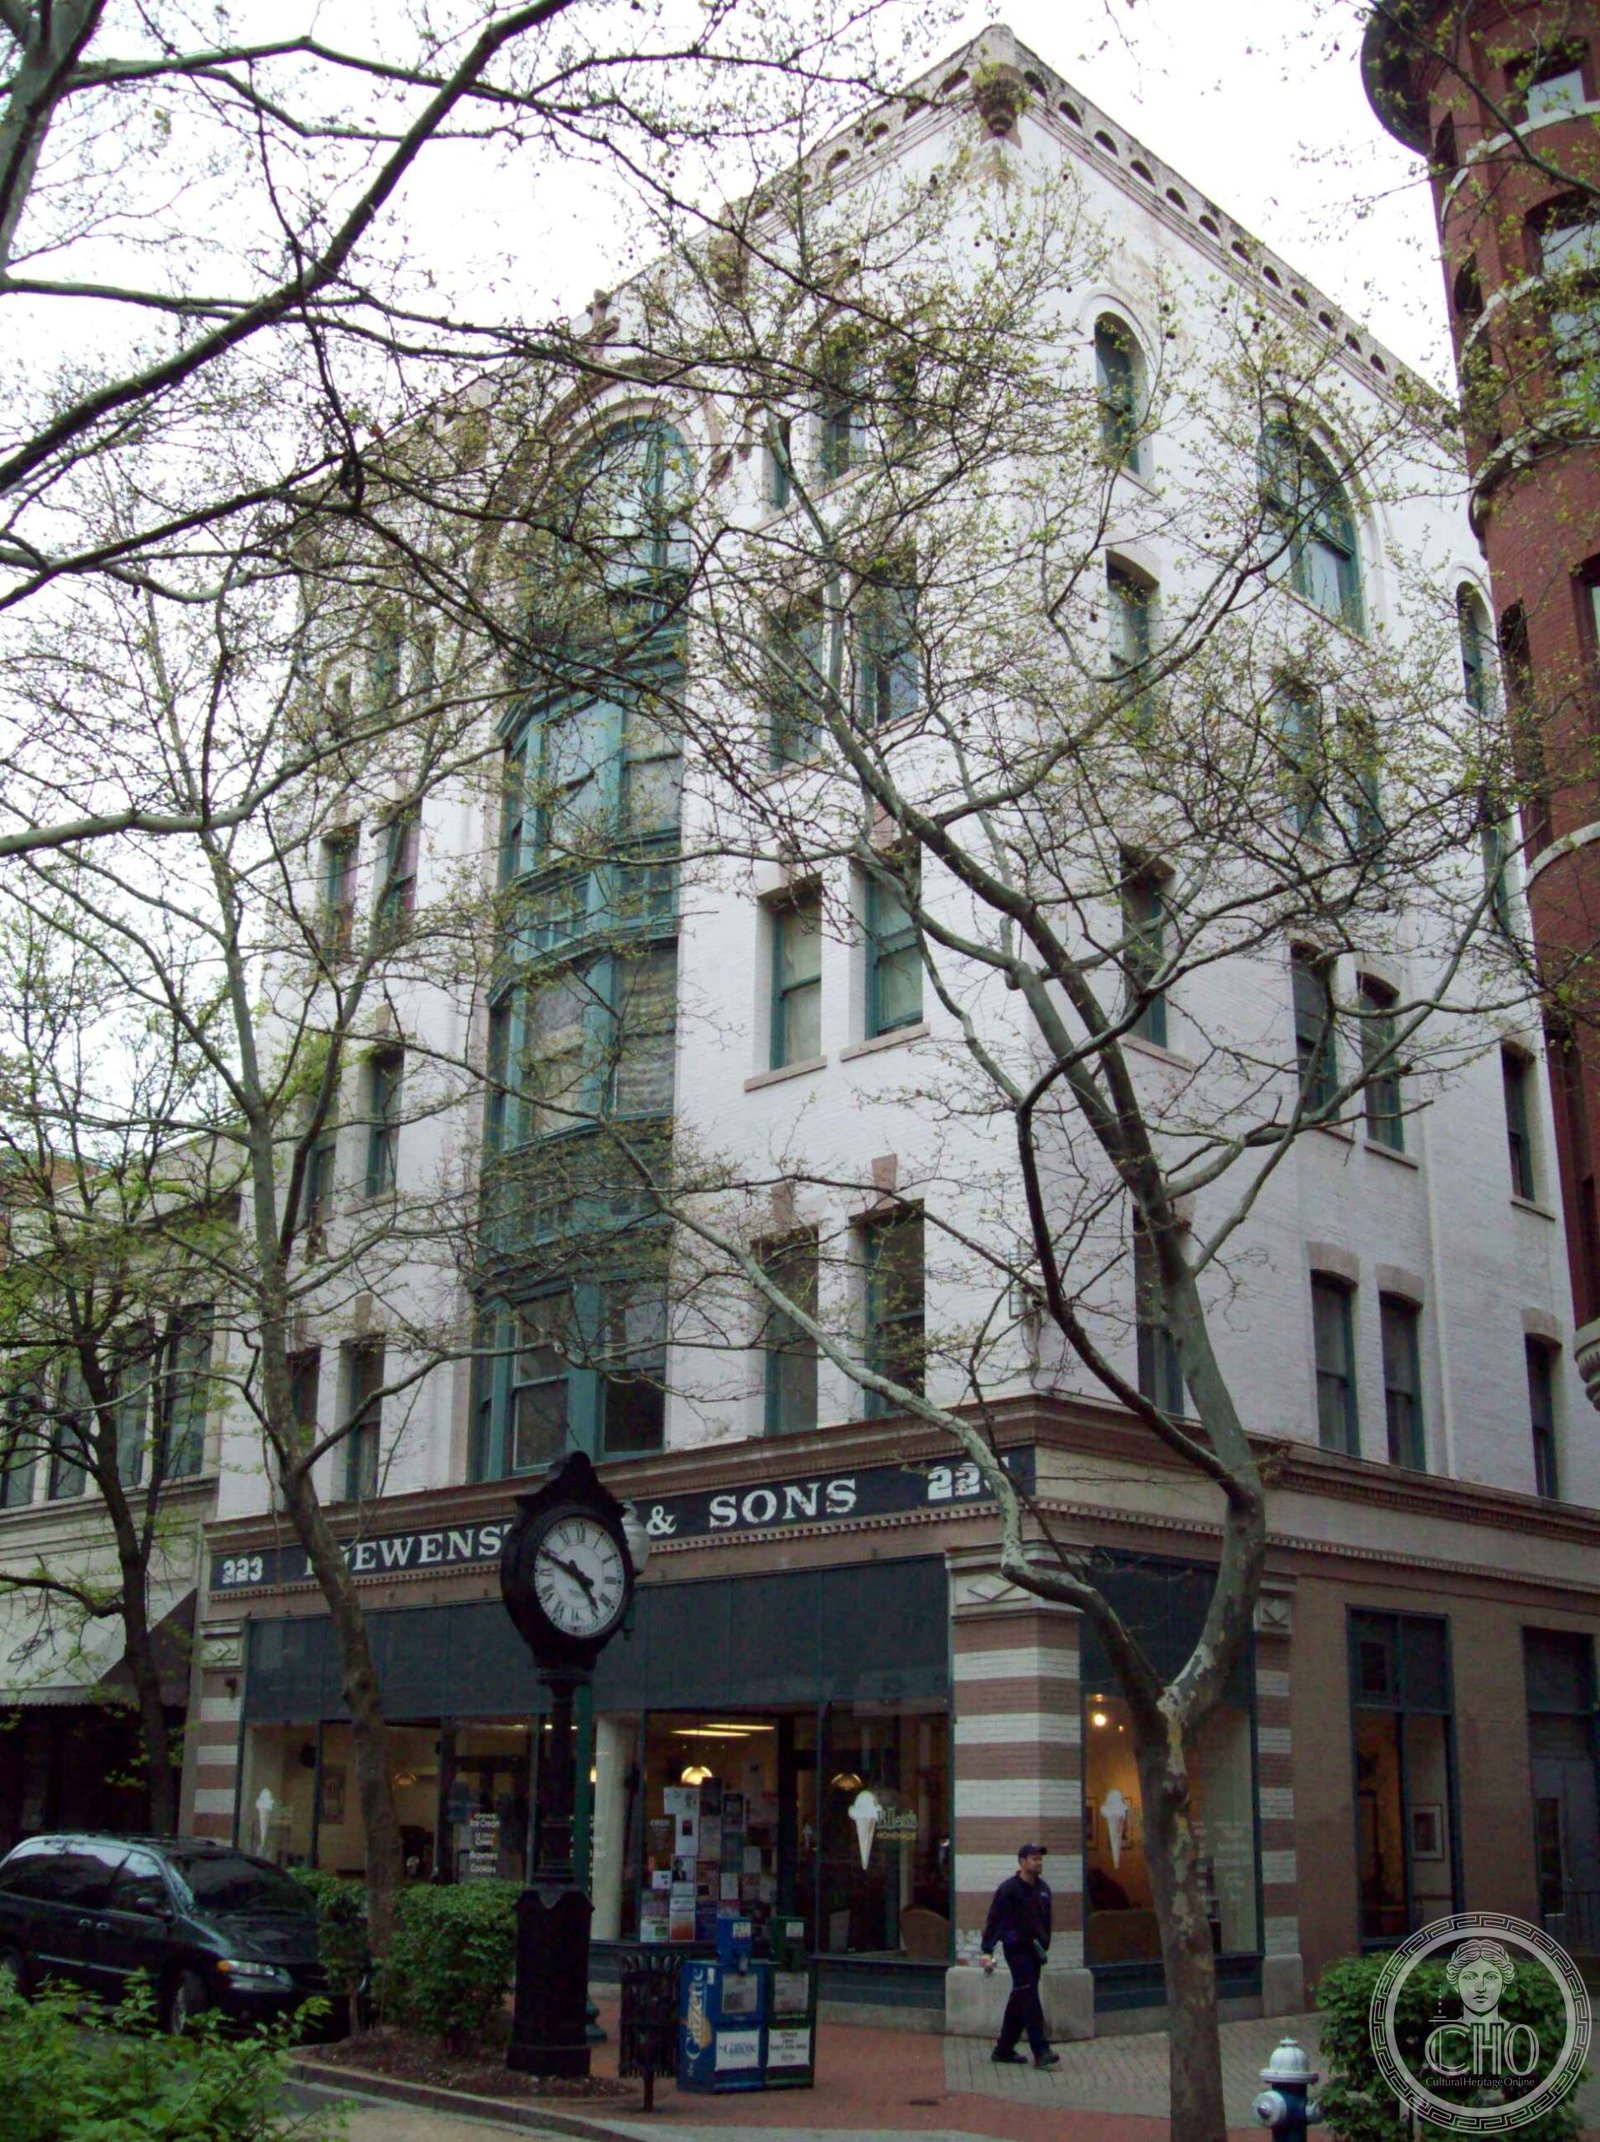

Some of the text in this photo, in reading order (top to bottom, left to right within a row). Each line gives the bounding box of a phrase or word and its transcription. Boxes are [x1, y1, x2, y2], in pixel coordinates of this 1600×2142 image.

[222, 1556, 263, 1585] 223
[646, 1504, 677, 1535] &
[709, 1478, 857, 1529] SONS
